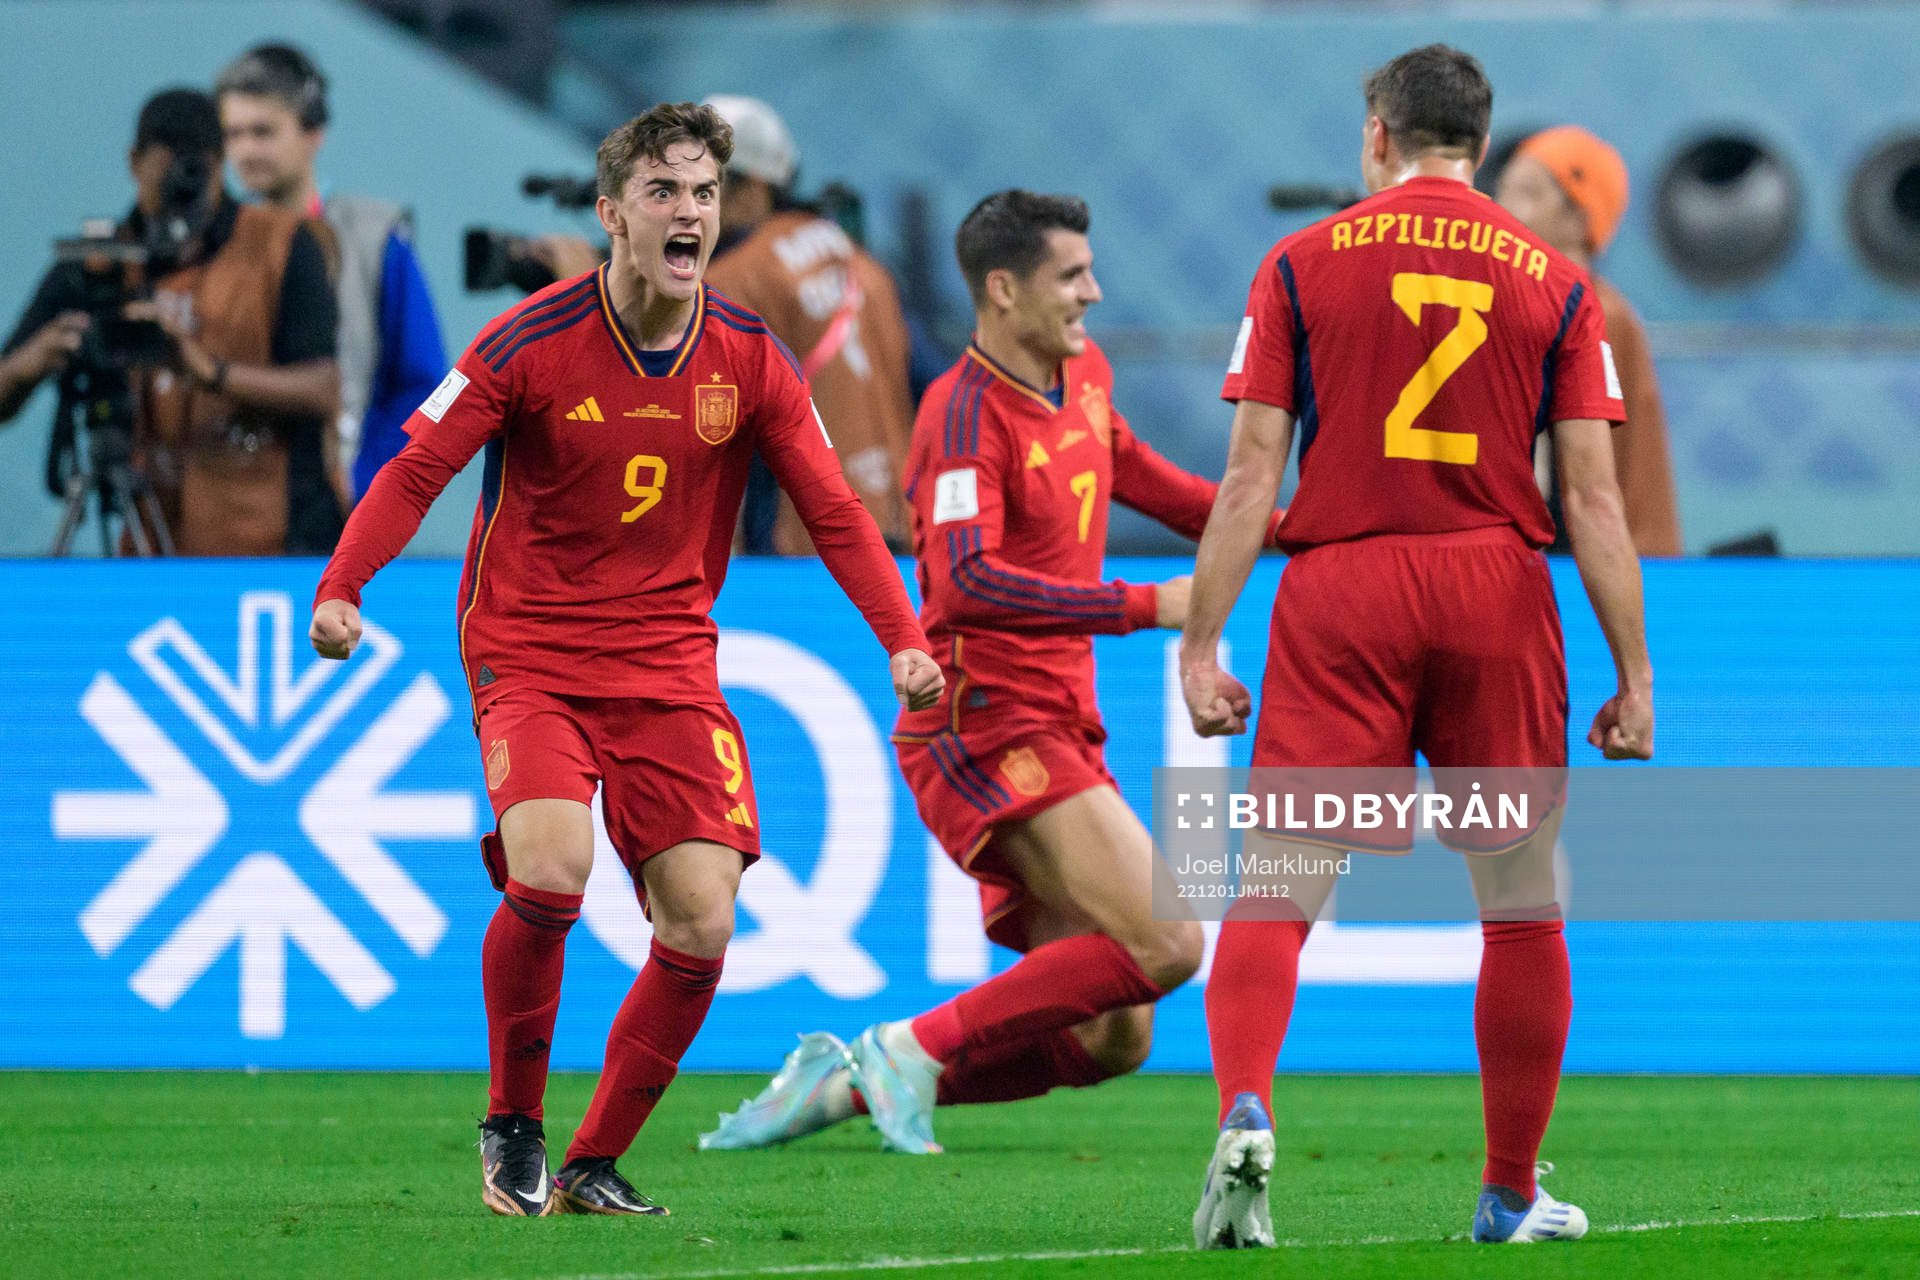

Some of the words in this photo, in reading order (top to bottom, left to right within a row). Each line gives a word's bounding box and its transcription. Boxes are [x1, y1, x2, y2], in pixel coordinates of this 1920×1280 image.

[1331, 213, 1549, 282] AZPILICUETA
[1384, 272, 1495, 466] 2
[620, 454, 668, 523] 9
[1070, 470, 1097, 544] 7
[712, 728, 744, 795] 9
